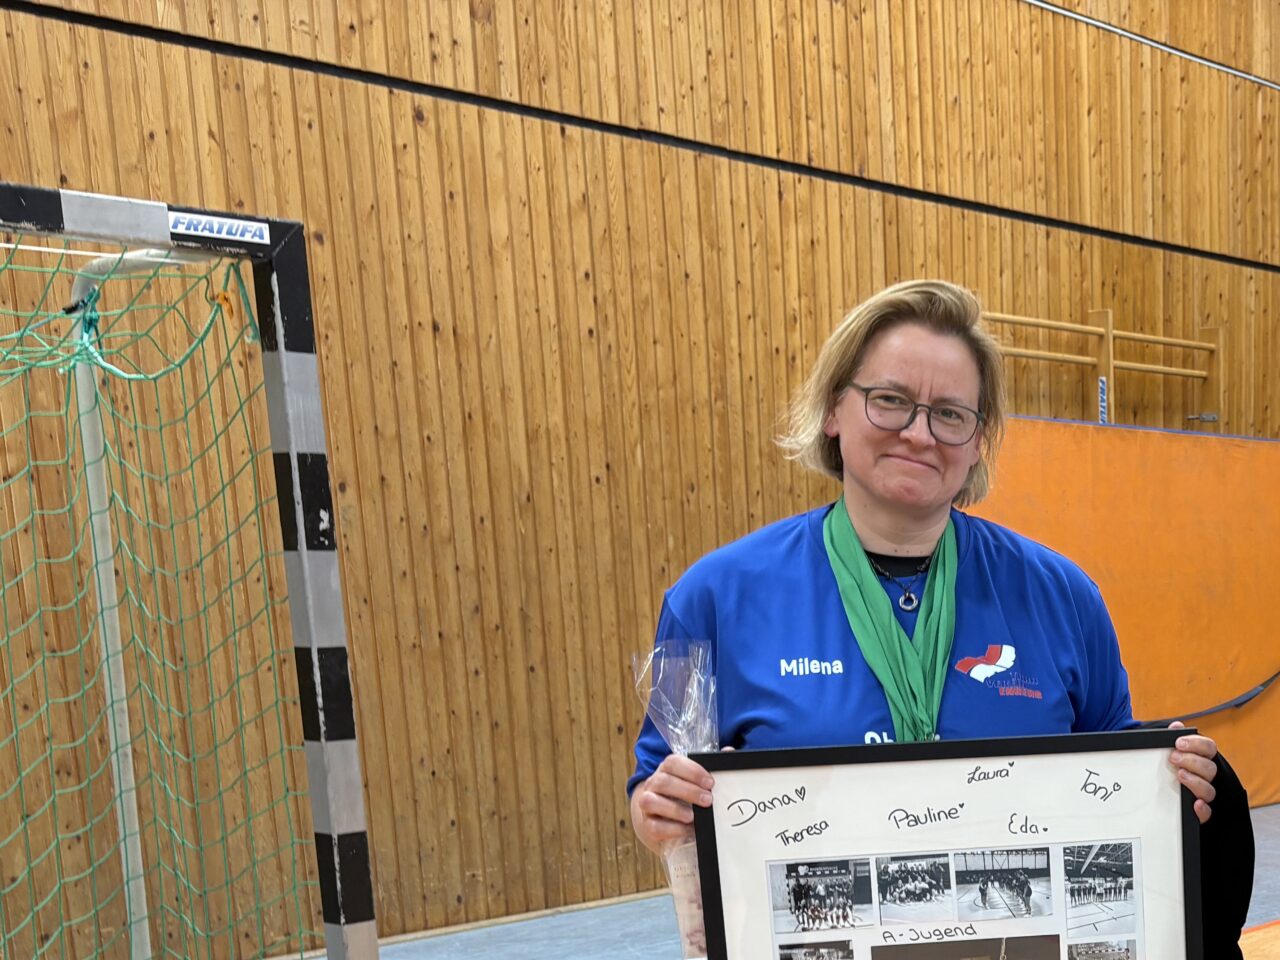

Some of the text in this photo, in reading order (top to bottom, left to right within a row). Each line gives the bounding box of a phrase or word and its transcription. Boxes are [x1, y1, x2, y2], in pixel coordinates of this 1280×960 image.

[171, 216, 265, 240] FRATUFA
[780, 657, 843, 677] Milena
[967, 766, 1009, 784] Laura
[1080, 769, 1114, 801] Toni
[727, 793, 796, 827] Dana
[888, 806, 960, 830] Pauline
[775, 820, 829, 847] Theresa
